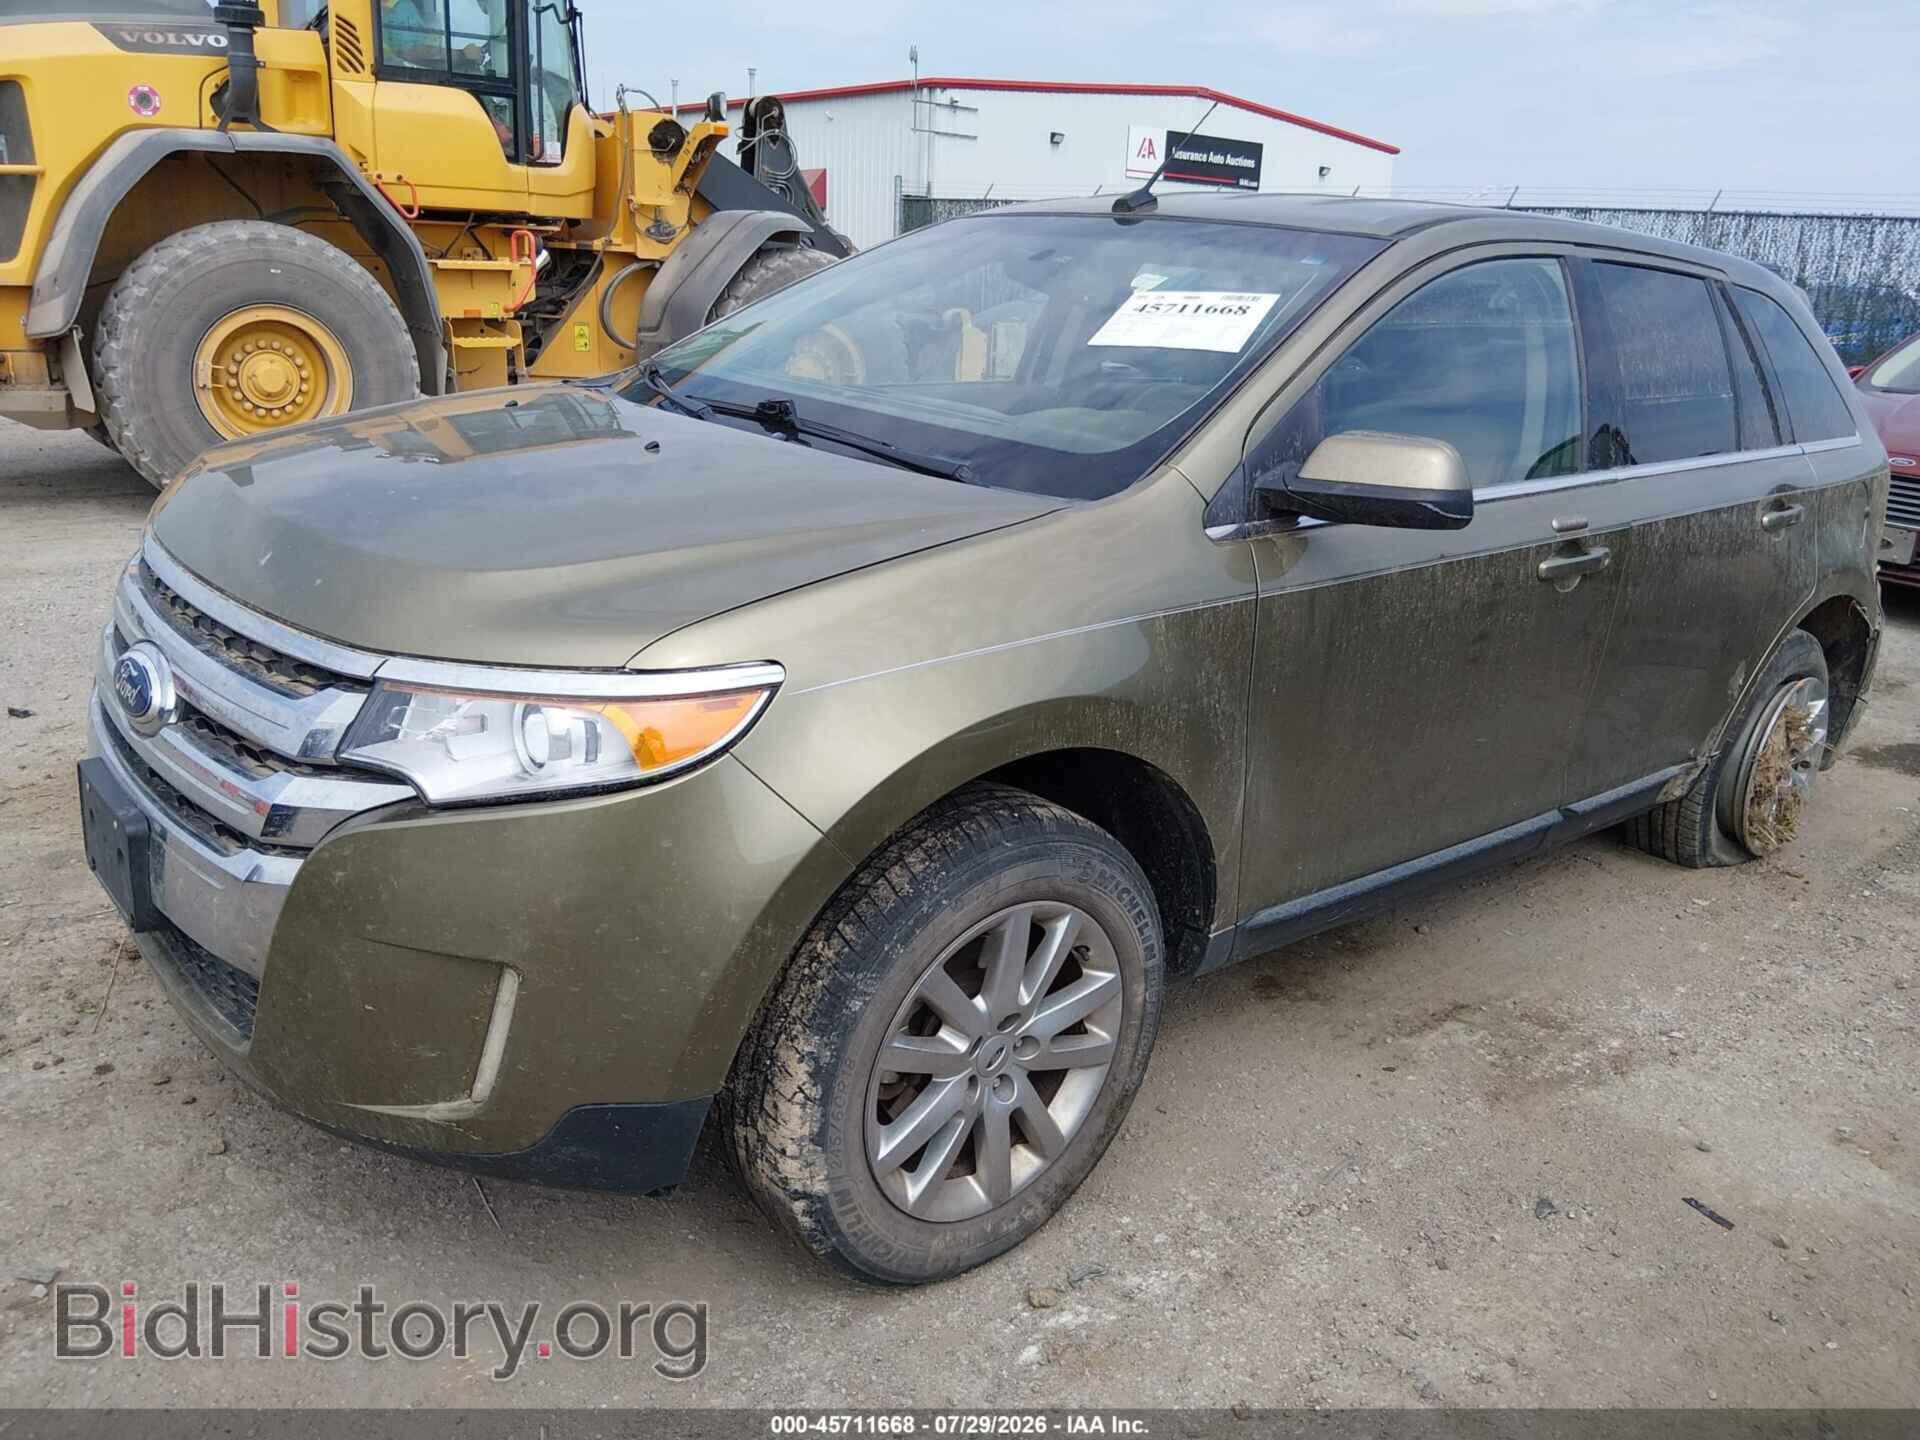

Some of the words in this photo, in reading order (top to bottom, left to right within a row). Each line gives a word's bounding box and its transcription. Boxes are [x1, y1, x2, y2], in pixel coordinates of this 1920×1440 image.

[119, 31, 229, 48] VOLVO
[1208, 151, 1225, 165] Auto
[1225, 153, 1255, 168] Auctions
[1132, 303, 1251, 315] 45711668
[116, 660, 142, 707] Ford
[1094, 868, 1158, 962] MICHELIN
